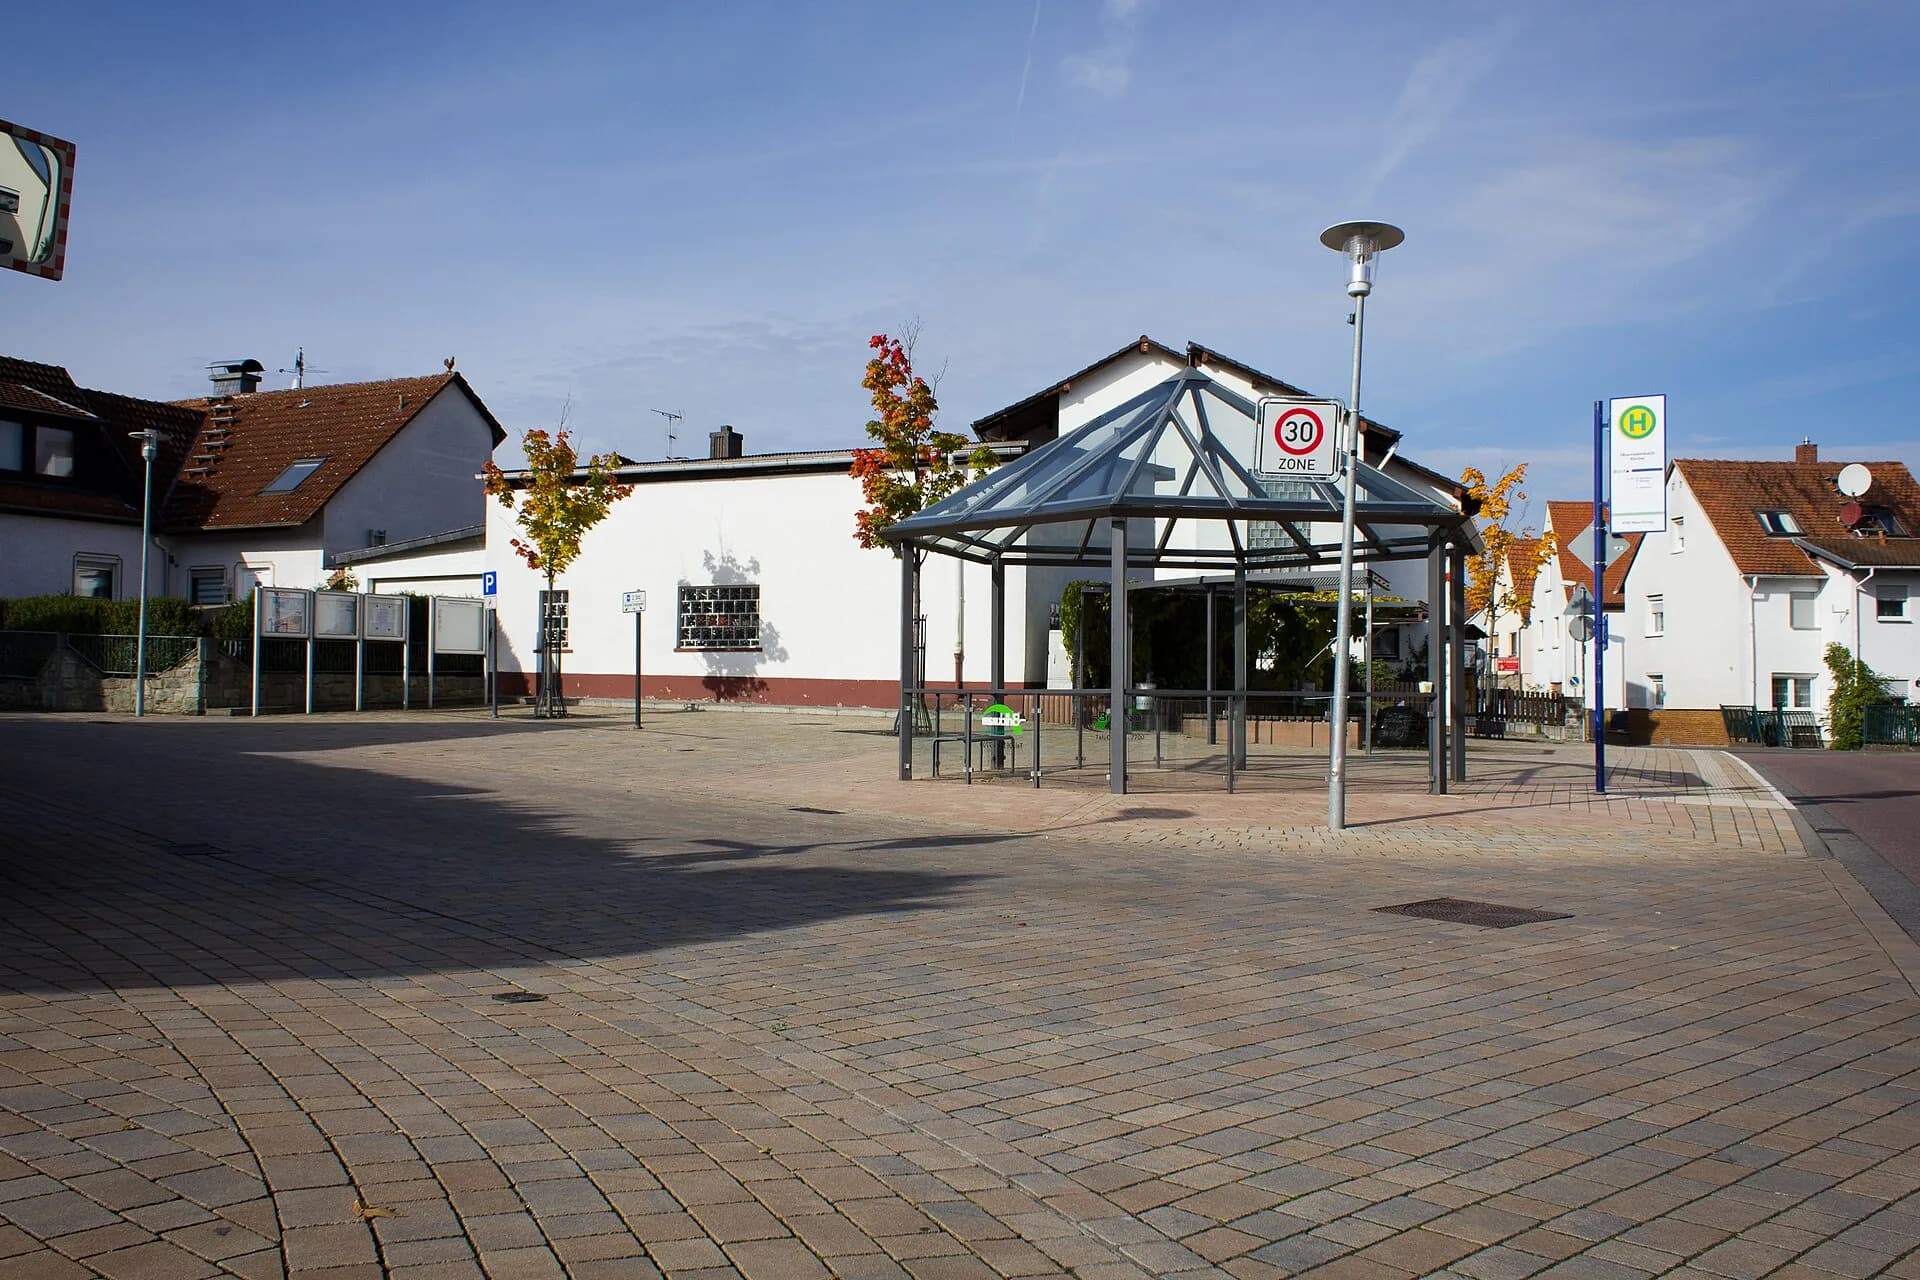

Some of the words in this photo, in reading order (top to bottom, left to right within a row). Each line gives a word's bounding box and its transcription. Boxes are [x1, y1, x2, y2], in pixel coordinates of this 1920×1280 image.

[1285, 421, 1314, 442] 30
[1629, 413, 1647, 432] H
[1278, 458, 1316, 471] ZONE
[485, 574, 494, 593] P
